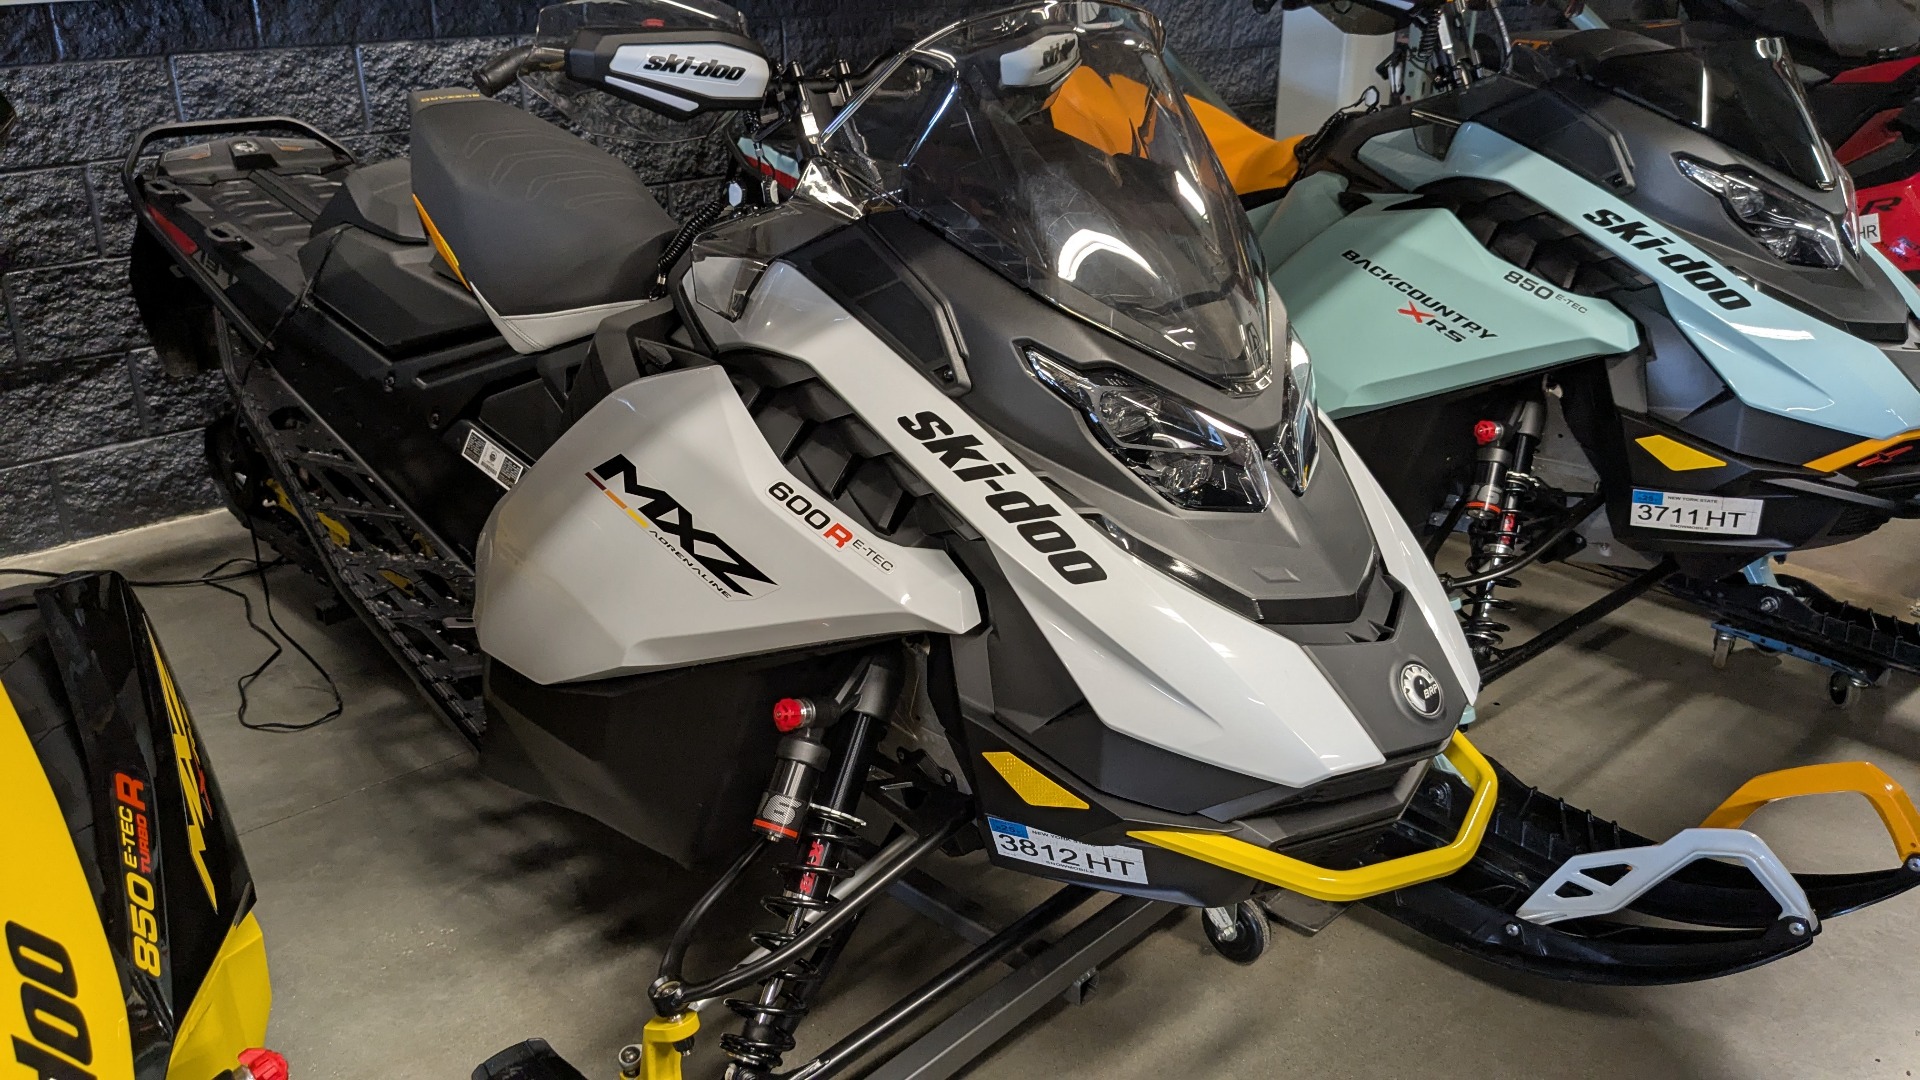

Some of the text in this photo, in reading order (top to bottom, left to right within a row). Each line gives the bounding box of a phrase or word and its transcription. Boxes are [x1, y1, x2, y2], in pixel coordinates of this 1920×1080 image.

[643, 53, 746, 81] ski-doo
[1341, 249, 1498, 340] BACKCOUNTRY
[1503, 270, 1588, 314] 850 E-TEC
[1582, 208, 1752, 311] ski-doo
[592, 453, 779, 597] MXZ
[897, 410, 1108, 585] ski-doo
[1637, 504, 1747, 528] 3711 HT
[649, 529, 732, 599] ADRENALINE
[852, 538, 894, 572] E-TEC
[1423, 683, 1438, 699] BRP
[115, 771, 152, 874] TURBO R
[998, 833, 1135, 876] 3812 HT
[118, 805, 162, 979] 850 E-TEC
